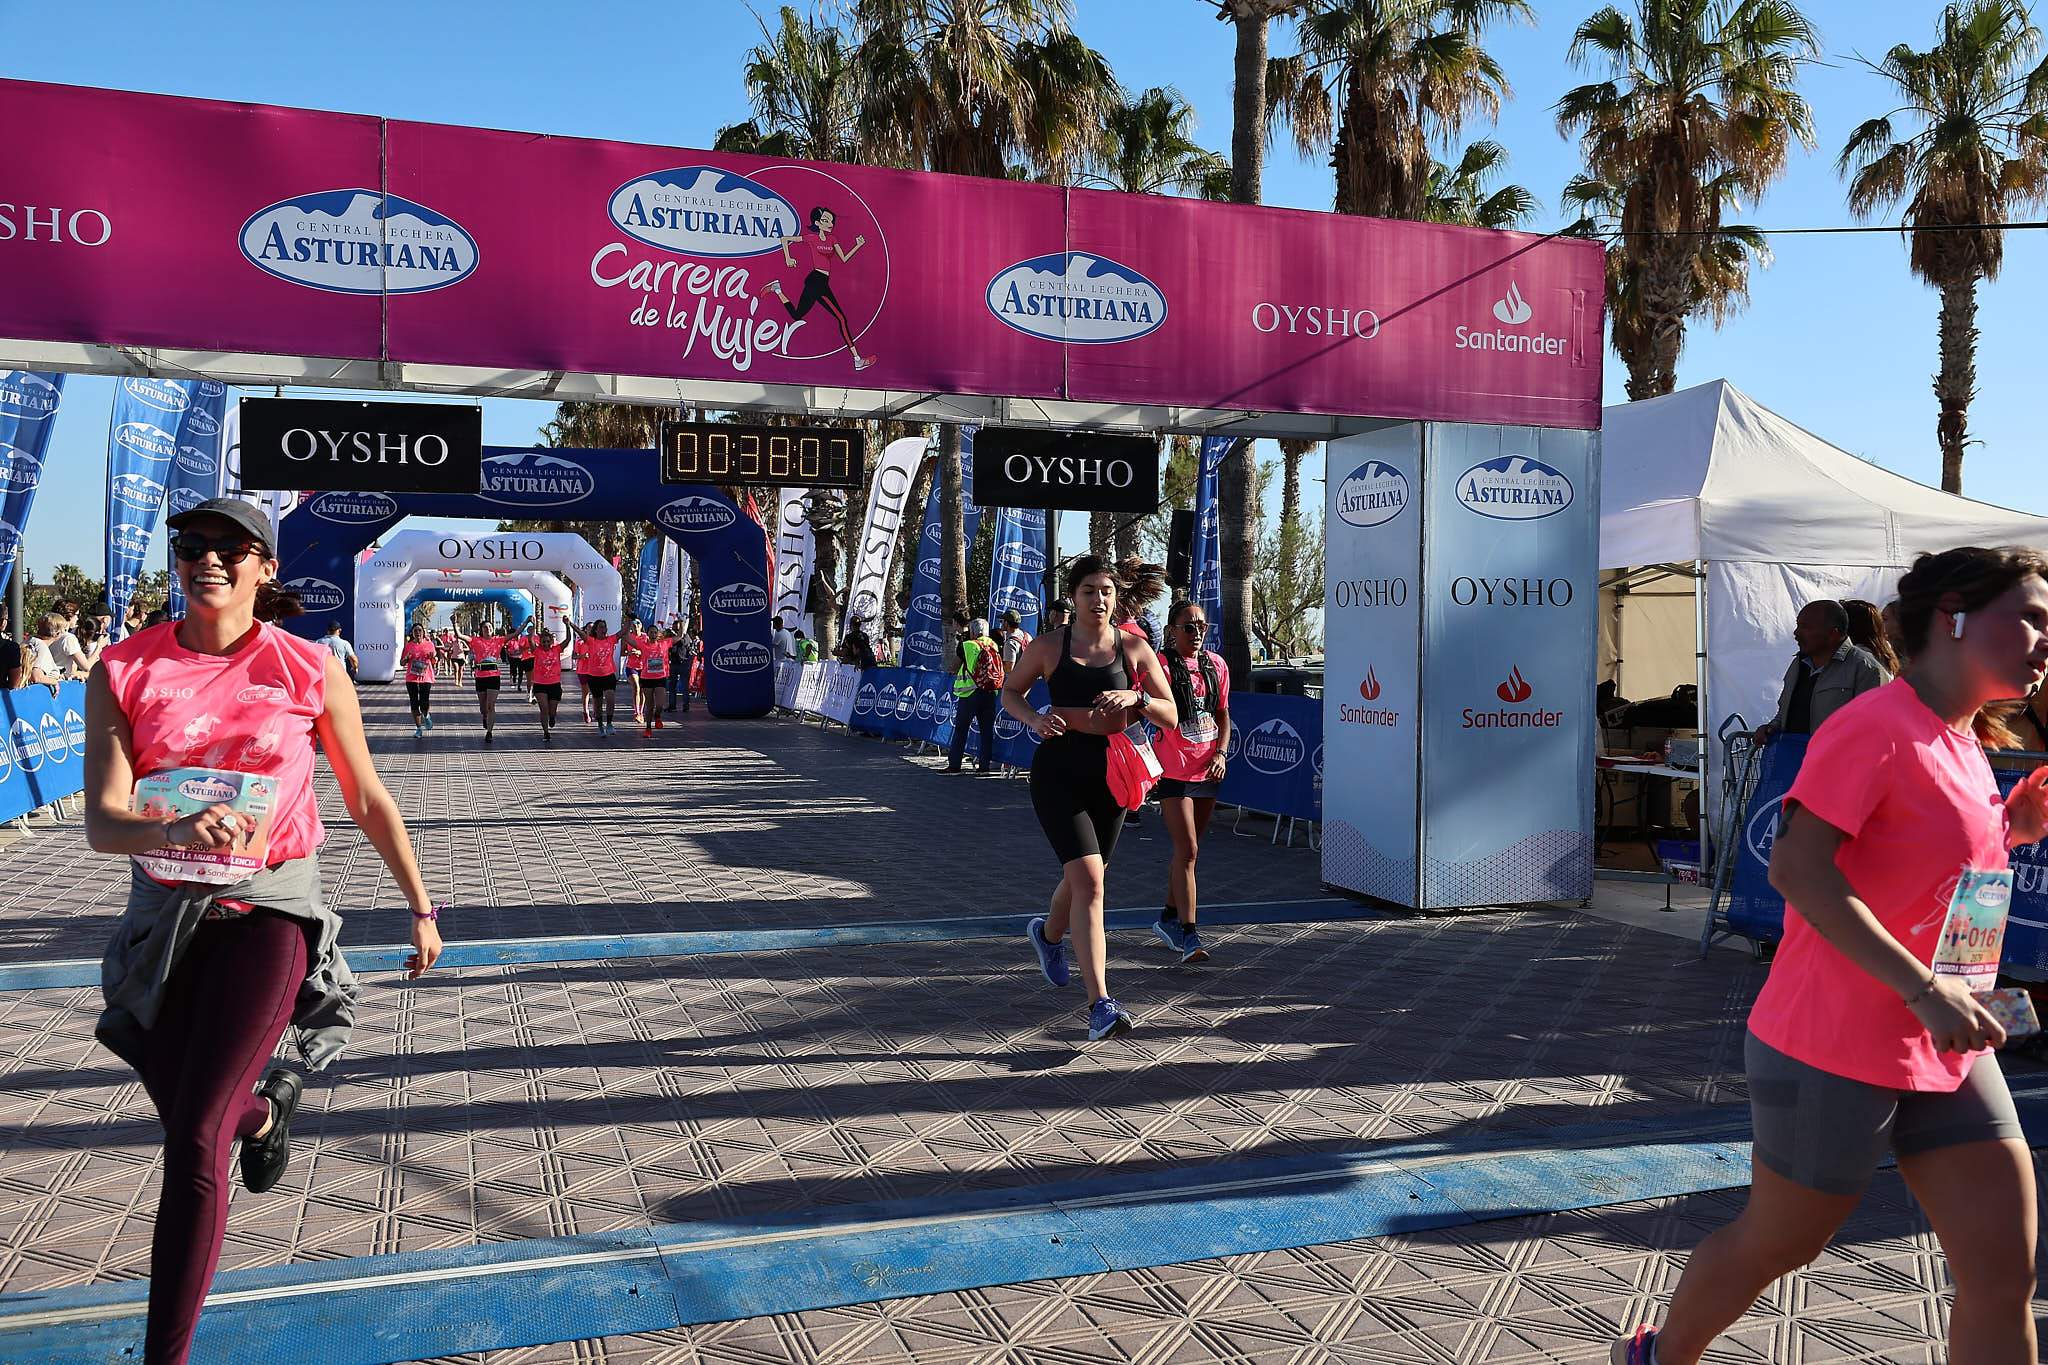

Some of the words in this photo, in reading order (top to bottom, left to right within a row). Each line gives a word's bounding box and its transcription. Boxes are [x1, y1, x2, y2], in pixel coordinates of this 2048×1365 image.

[624, 192, 785, 239] ASTURIANA
[654, 194, 713, 207] CENTRAL
[720, 199, 780, 213] LECHERA
[296, 222, 371, 236] CENTRAL
[258, 221, 461, 272] ASTURIANA
[590, 242, 749, 299] Carrera
[1029, 280, 1085, 292] CENTRAL
[1091, 285, 1149, 297] LECHERA
[1001, 280, 1154, 323] ASTURIANA
[630, 294, 660, 327] de
[666, 296, 687, 329] la
[682, 296, 806, 372] Mujer
[1252, 301, 1380, 340] OYSHO
[1455, 325, 1567, 356] Santander
[281, 428, 449, 466] OYSHO
[677, 432, 849, 477] 00:38:07
[1004, 454, 1133, 488] OYSHO
[1340, 489, 1403, 514] ASTURIANA
[1464, 477, 1565, 505] ASTURIANA
[315, 499, 391, 516] ASTURIANA
[663, 510, 731, 524] ASTURIANA
[438, 538, 544, 561] OYSHO
[853, 465, 909, 623] OYSHO
[374, 560, 407, 569] OYSHO
[573, 562, 604, 570] OYSHO
[713, 595, 766, 608] ASTURIANA
[1335, 577, 1408, 608] OYSHO
[1451, 576, 1574, 607] OYSHO
[359, 601, 390, 609] OYSHO
[588, 603, 618, 611] OYSHO
[358, 643, 389, 651] OYSHO
[715, 654, 769, 667] ASTURIANA
[1340, 703, 1400, 728] Santander
[1462, 708, 1563, 729] Santander
[1247, 736, 1297, 763] ASTURIANA
[182, 784, 234, 799] ASTURIANA
